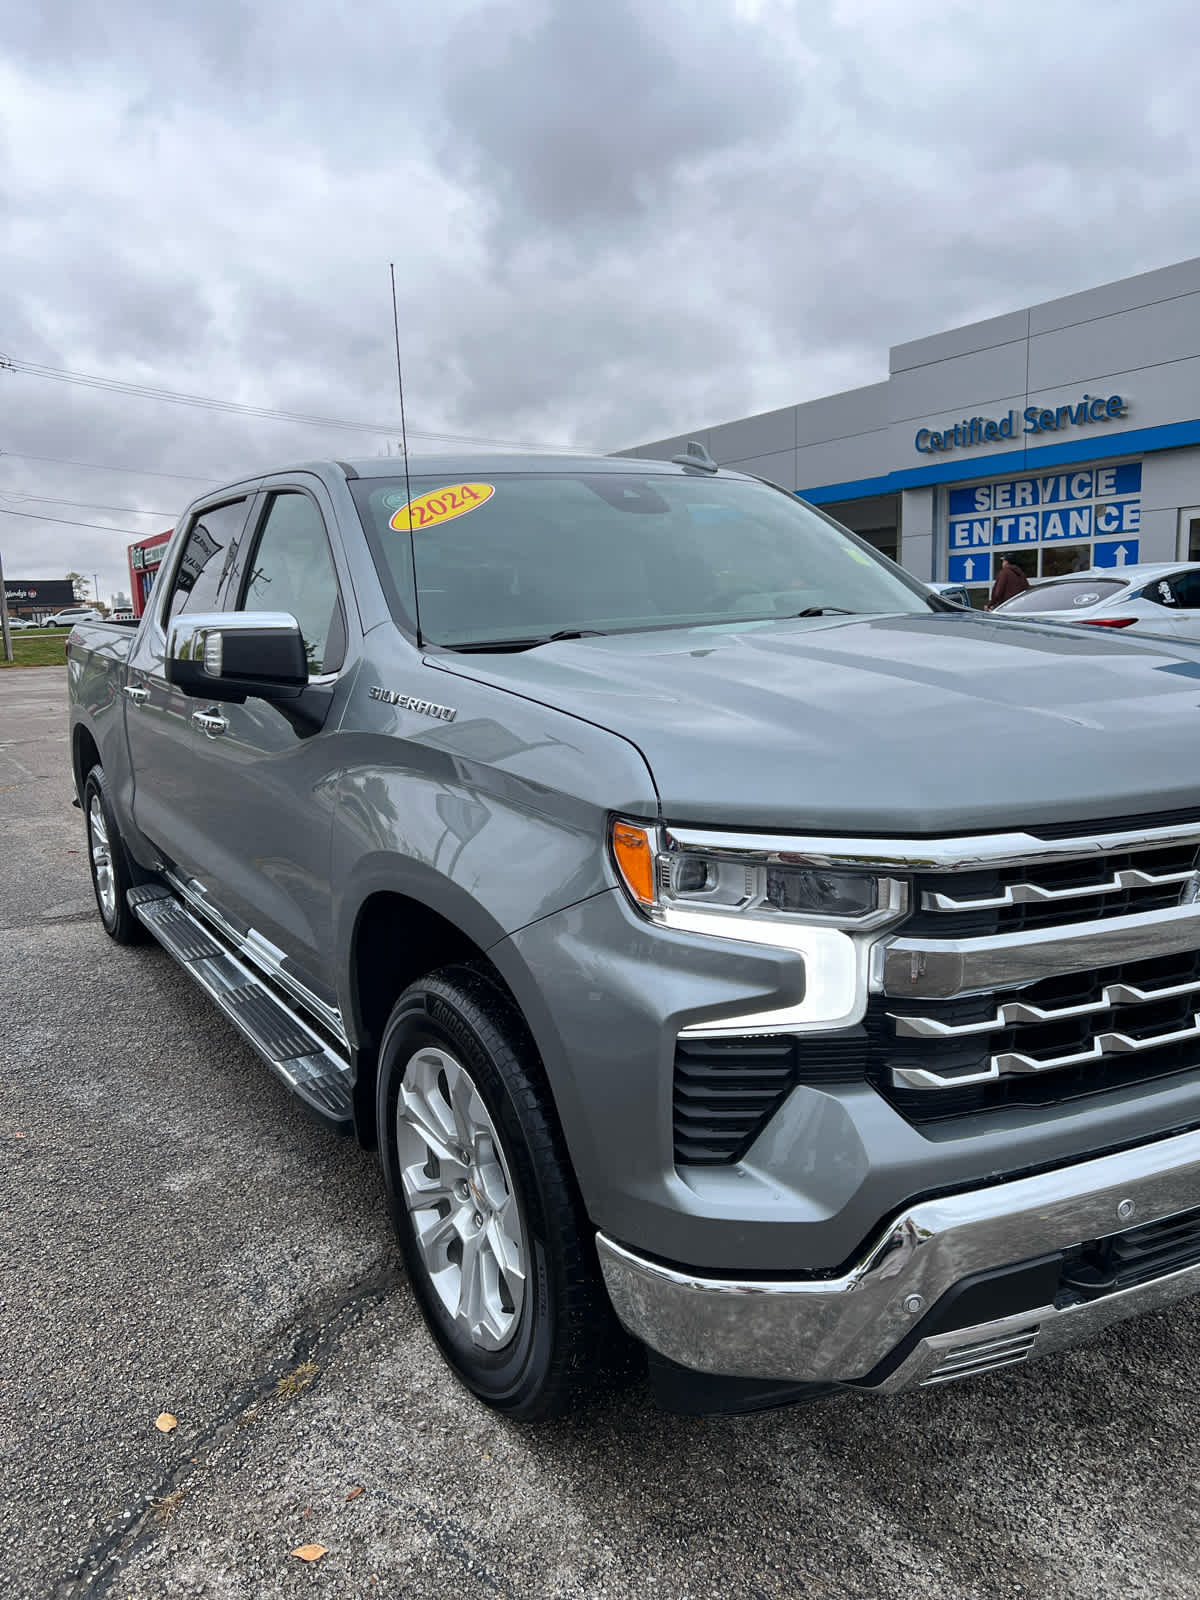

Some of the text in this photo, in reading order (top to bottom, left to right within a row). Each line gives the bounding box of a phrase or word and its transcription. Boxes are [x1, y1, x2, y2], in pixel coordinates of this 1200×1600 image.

[915, 394, 1124, 453] Certified Service
[411, 486, 480, 525] 2024
[974, 468, 1118, 512] SERVICE
[954, 503, 1141, 547] ENTRANCE
[367, 685, 457, 722] SILVERADO
